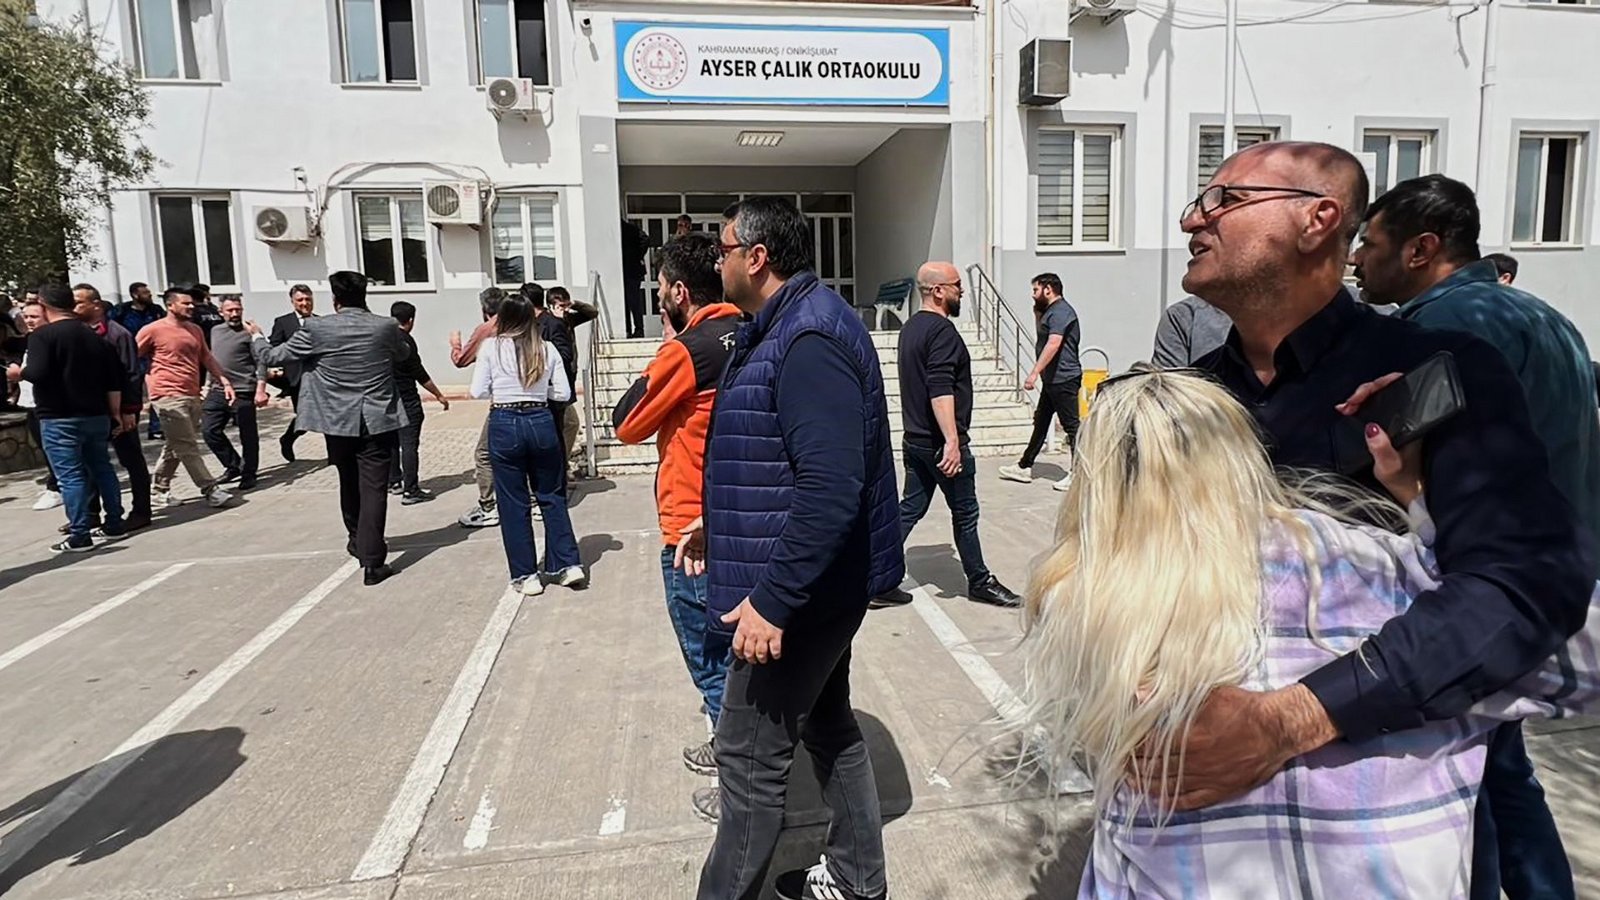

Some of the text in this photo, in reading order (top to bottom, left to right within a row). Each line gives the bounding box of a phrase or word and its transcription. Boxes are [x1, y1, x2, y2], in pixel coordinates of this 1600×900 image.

[700, 59, 756, 77] AYSER
[761, 60, 813, 80] ÇALIK
[817, 61, 920, 79] ORTAOKULU
